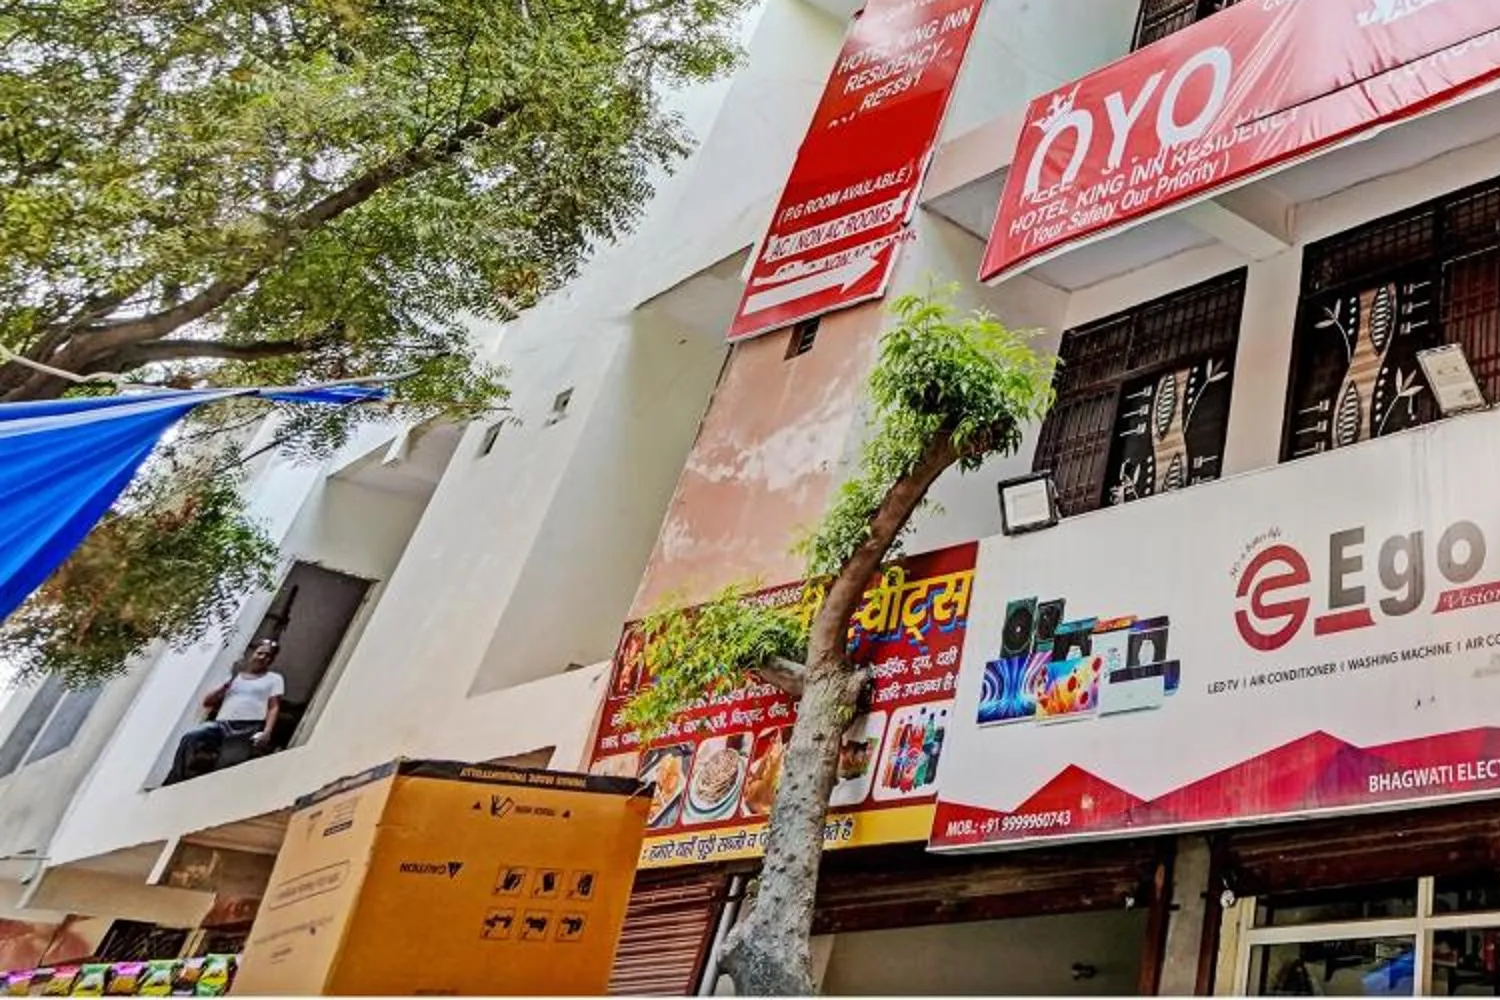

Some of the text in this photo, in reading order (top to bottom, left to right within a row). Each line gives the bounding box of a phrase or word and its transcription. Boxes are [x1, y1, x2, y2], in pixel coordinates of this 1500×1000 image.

[1020, 45, 1233, 198] OYO
[804, 190, 841, 216] ROOM
[844, 202, 894, 233] ROOMS
[1008, 197, 1069, 238] HOTEL
[1075, 173, 1126, 209] KING
[1067, 200, 1118, 231] Safety
[1121, 186, 1153, 210] Our
[1328, 519, 1487, 617] Ego
[1207, 681, 1226, 695] LED
[1227, 678, 1240, 691] TV
[1249, 674, 1268, 688] AIR
[1267, 662, 1337, 685] CONDITIONER
[1348, 652, 1399, 671] WASHING
[1400, 641, 1453, 662] MACHINE
[1465, 636, 1486, 651] AIR
[1369, 765, 1454, 792] BHAGWATI
[980, 817, 1000, 833] +91
